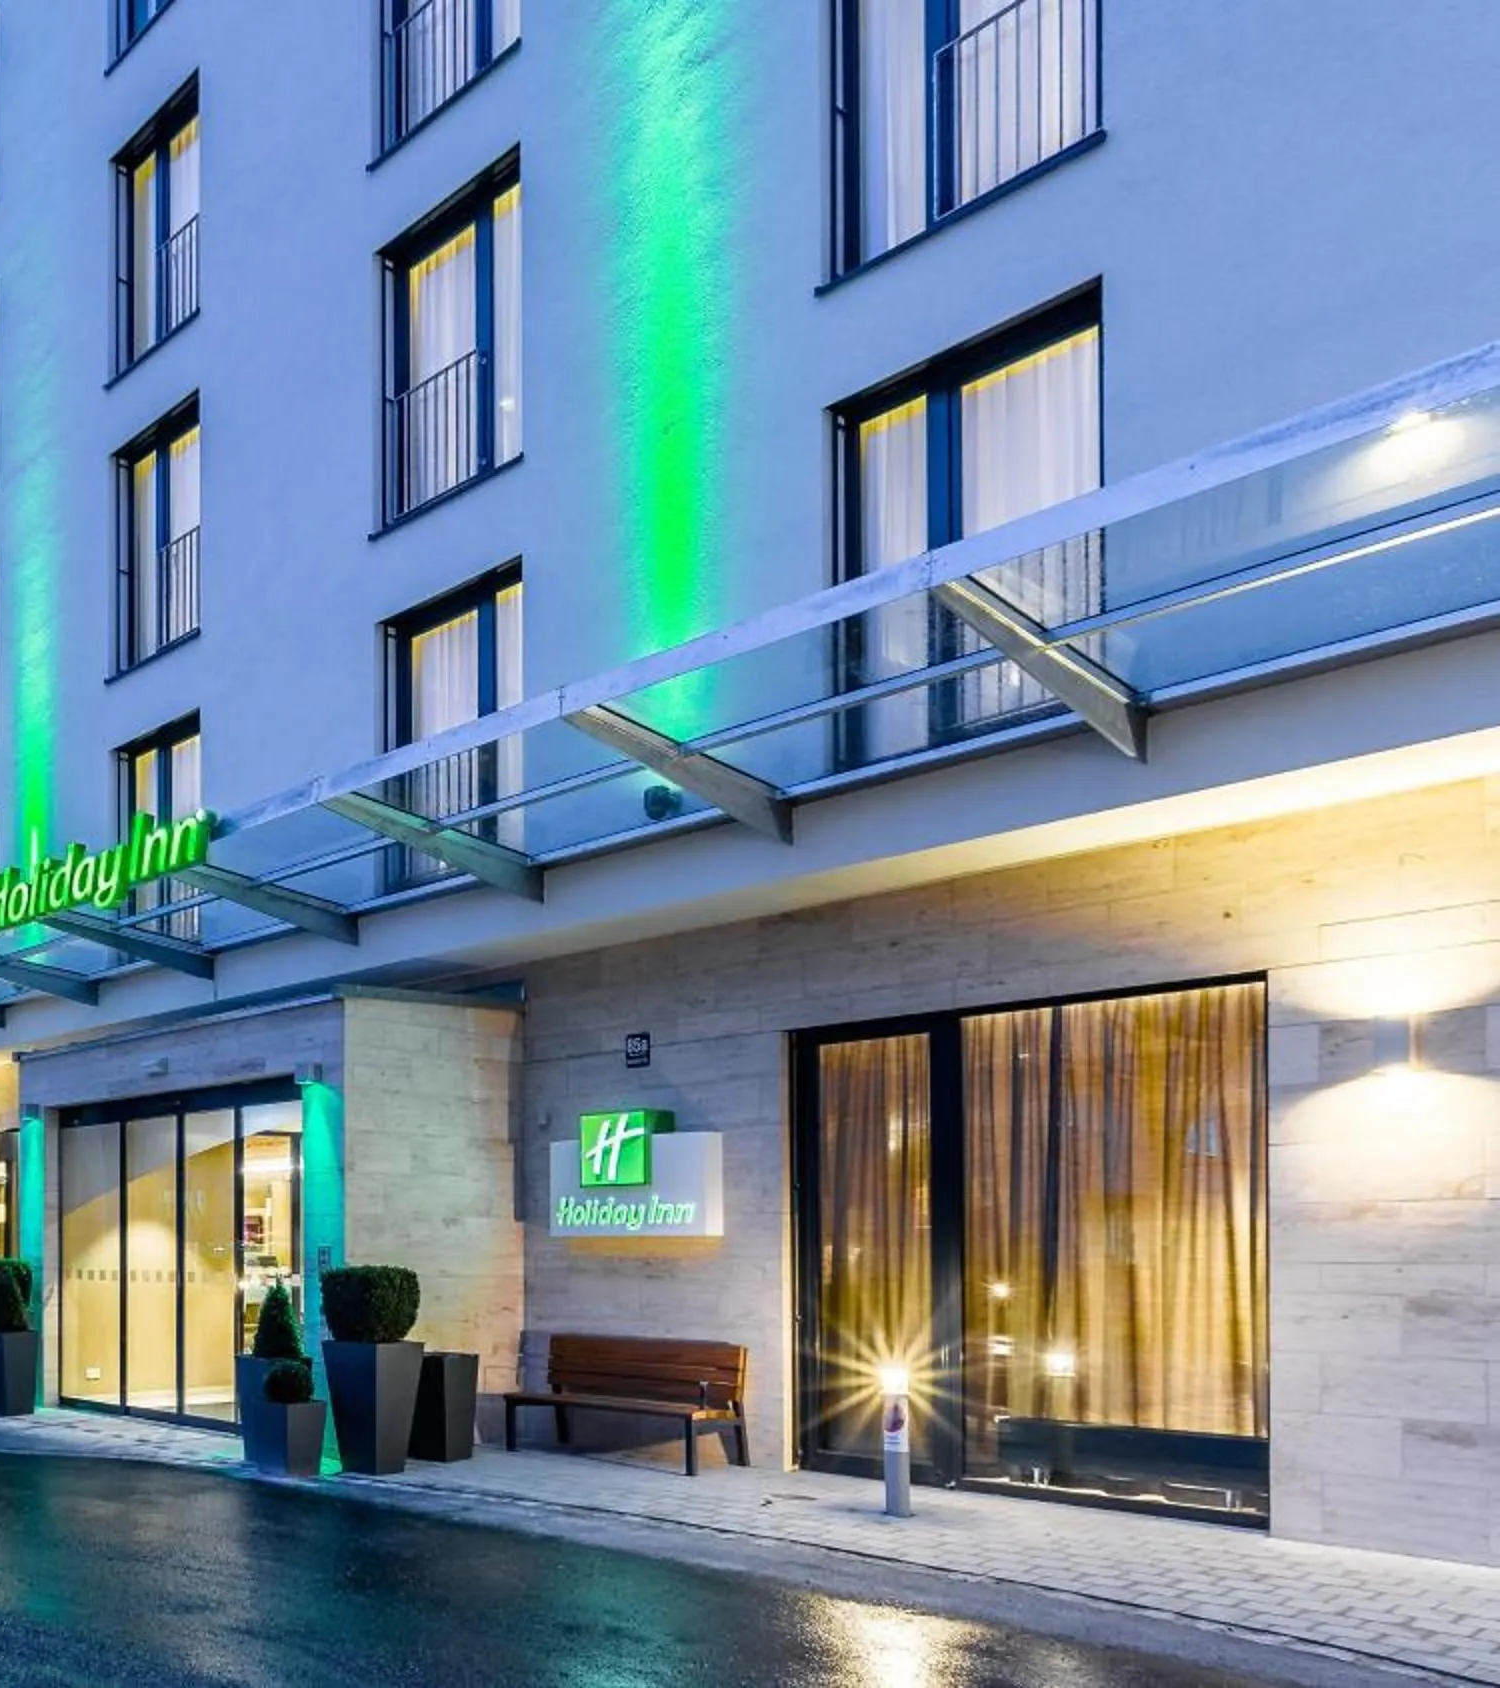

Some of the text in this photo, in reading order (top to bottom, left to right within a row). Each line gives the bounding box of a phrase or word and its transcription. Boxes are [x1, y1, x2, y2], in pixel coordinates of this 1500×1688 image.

[129, 812, 205, 884] Inn
[585, 1113, 645, 1181] H
[556, 1193, 696, 1231] Holiday Inn
